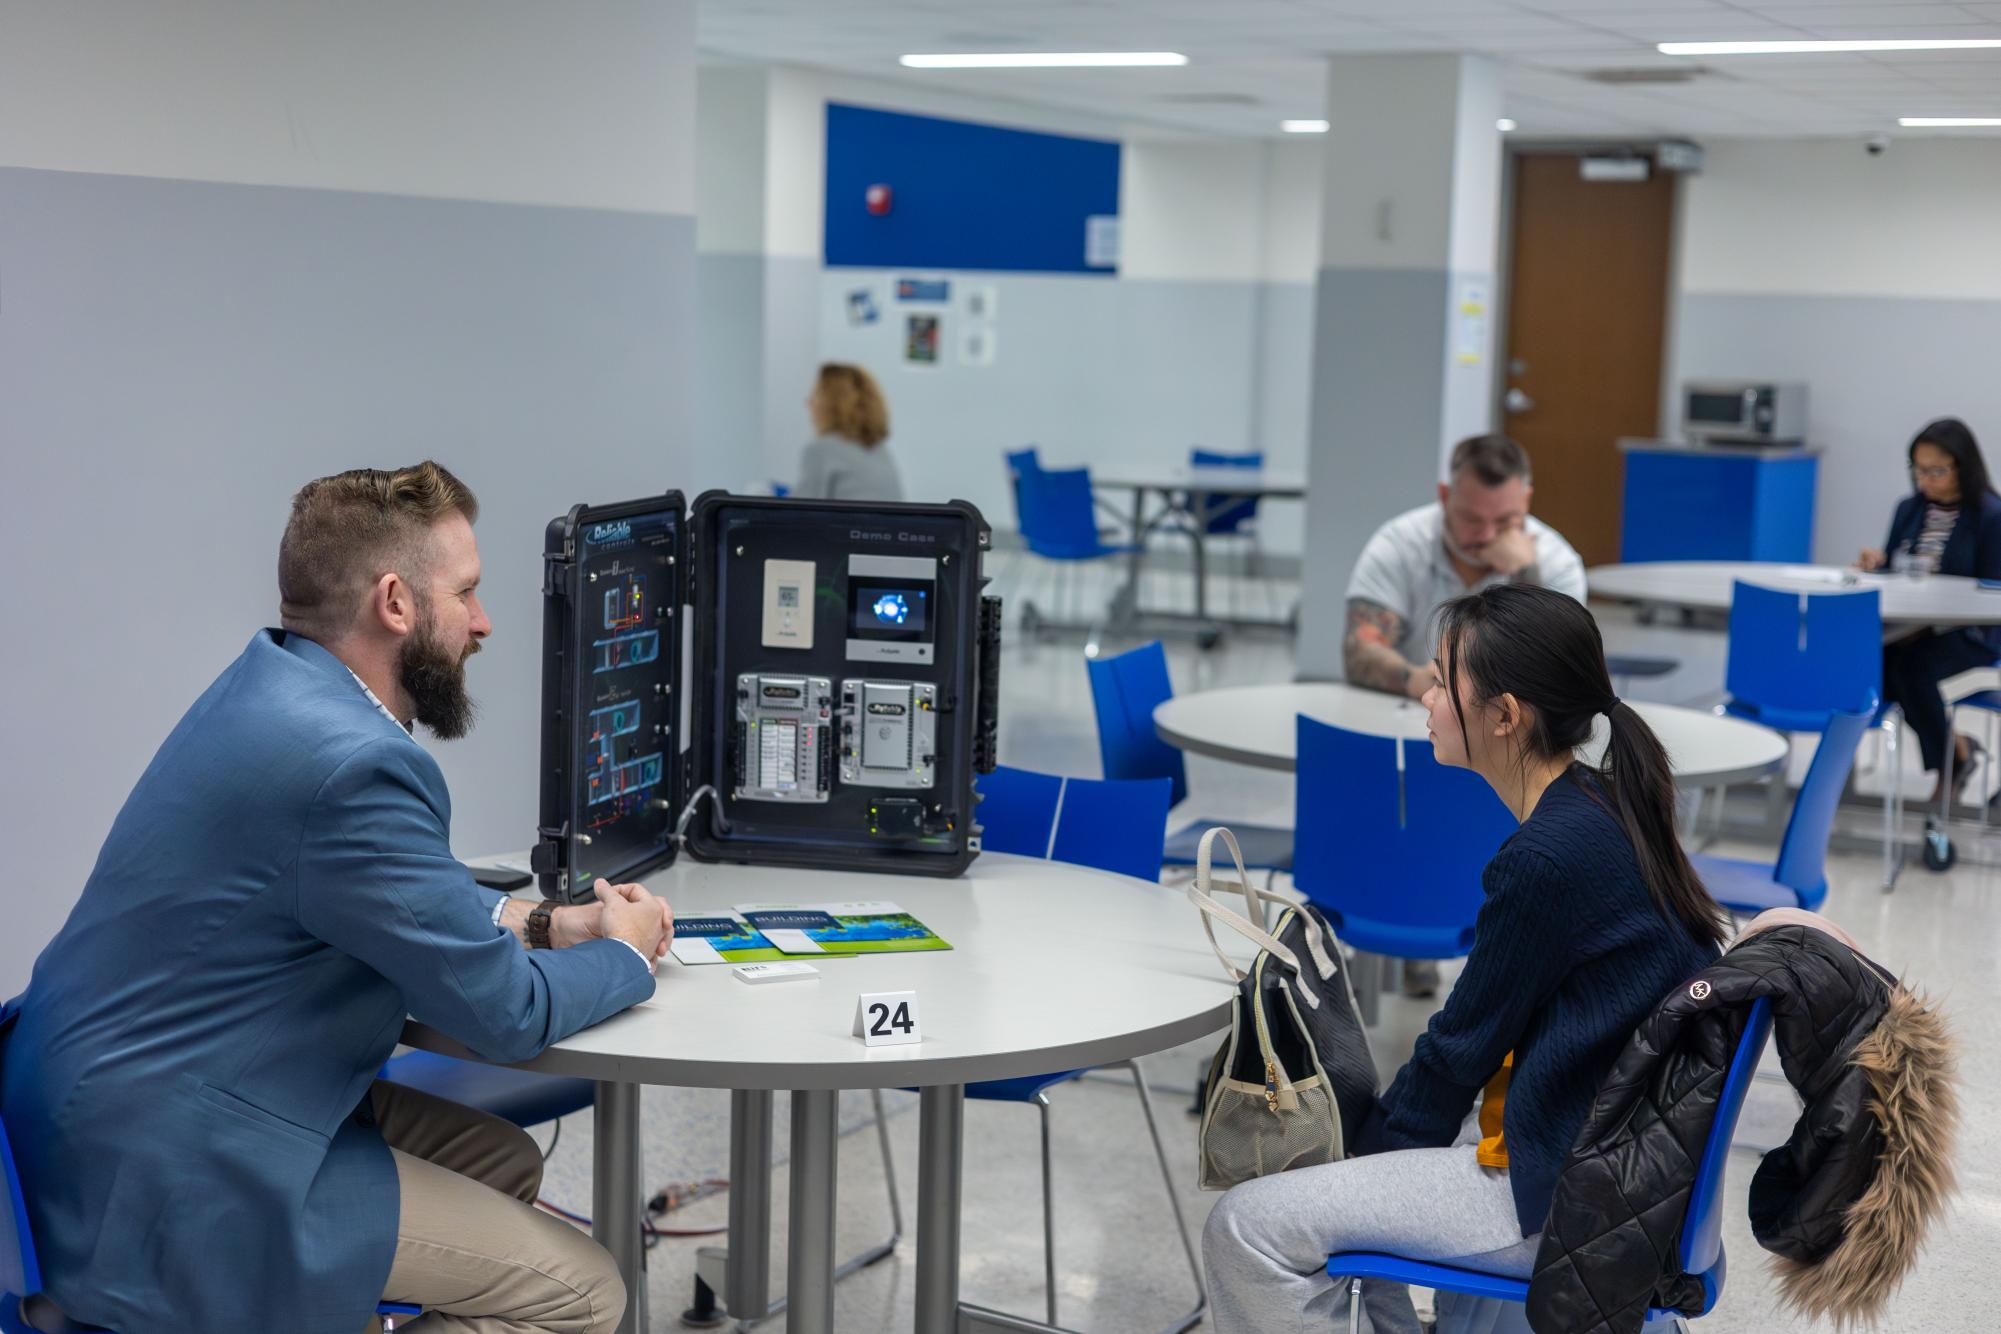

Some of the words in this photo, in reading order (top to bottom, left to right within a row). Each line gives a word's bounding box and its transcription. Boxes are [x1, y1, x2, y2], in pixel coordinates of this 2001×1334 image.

[594, 521, 630, 540] Reliable
[849, 530, 892, 541] Demo
[898, 532, 936, 543] Case
[754, 915, 828, 923] BUILDING
[868, 1001, 914, 1037] 24
